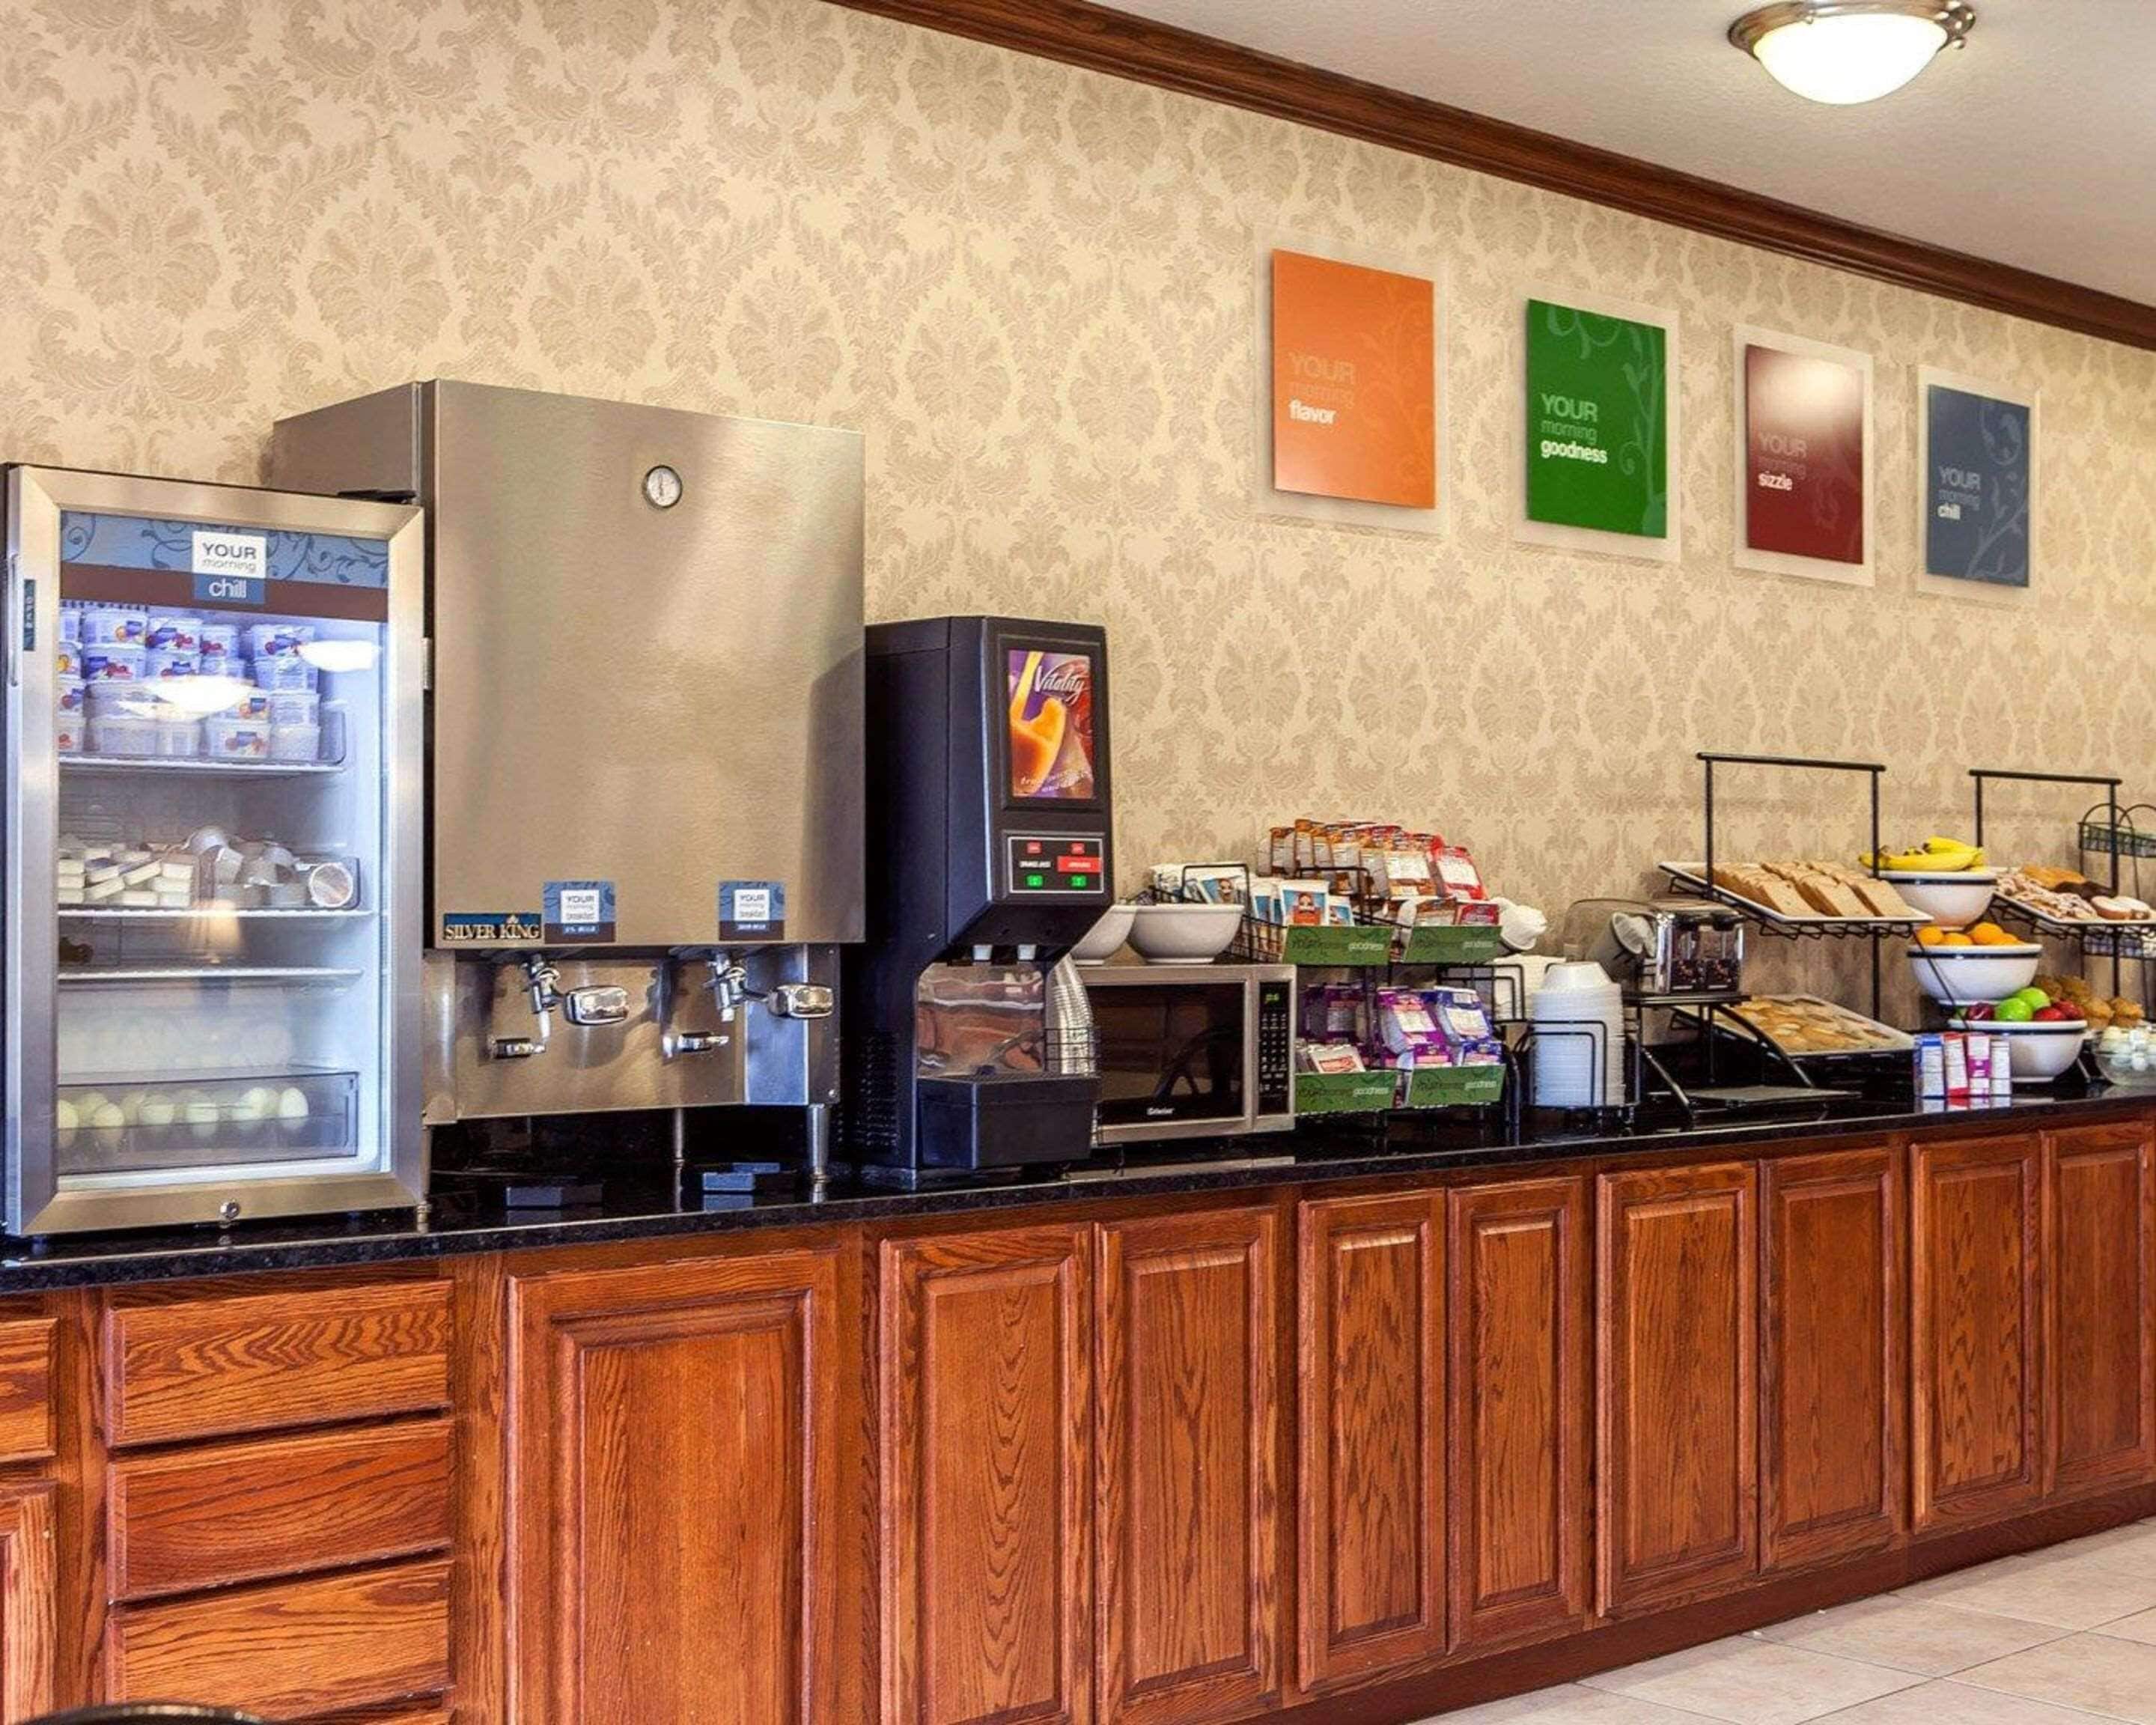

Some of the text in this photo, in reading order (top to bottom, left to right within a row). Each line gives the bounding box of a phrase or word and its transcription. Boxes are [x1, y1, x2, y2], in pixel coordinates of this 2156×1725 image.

[1288, 352, 1354, 385] YOUR
[1289, 399, 1336, 425] flavor
[1541, 393, 1598, 423] YOUR
[1541, 420, 1598, 445] morning
[1541, 439, 1608, 463] goodness
[1758, 432, 1807, 458] YOUR
[1758, 470, 1793, 491] sizzle
[1937, 466, 1981, 490] YOUR
[1937, 502, 1961, 520] chill
[202, 542, 257, 559] YOUR
[203, 559, 257, 574] morning
[209, 577, 246, 598] chill
[1034, 659, 1089, 705] Vitality
[445, 923, 540, 940] SILVER KING
